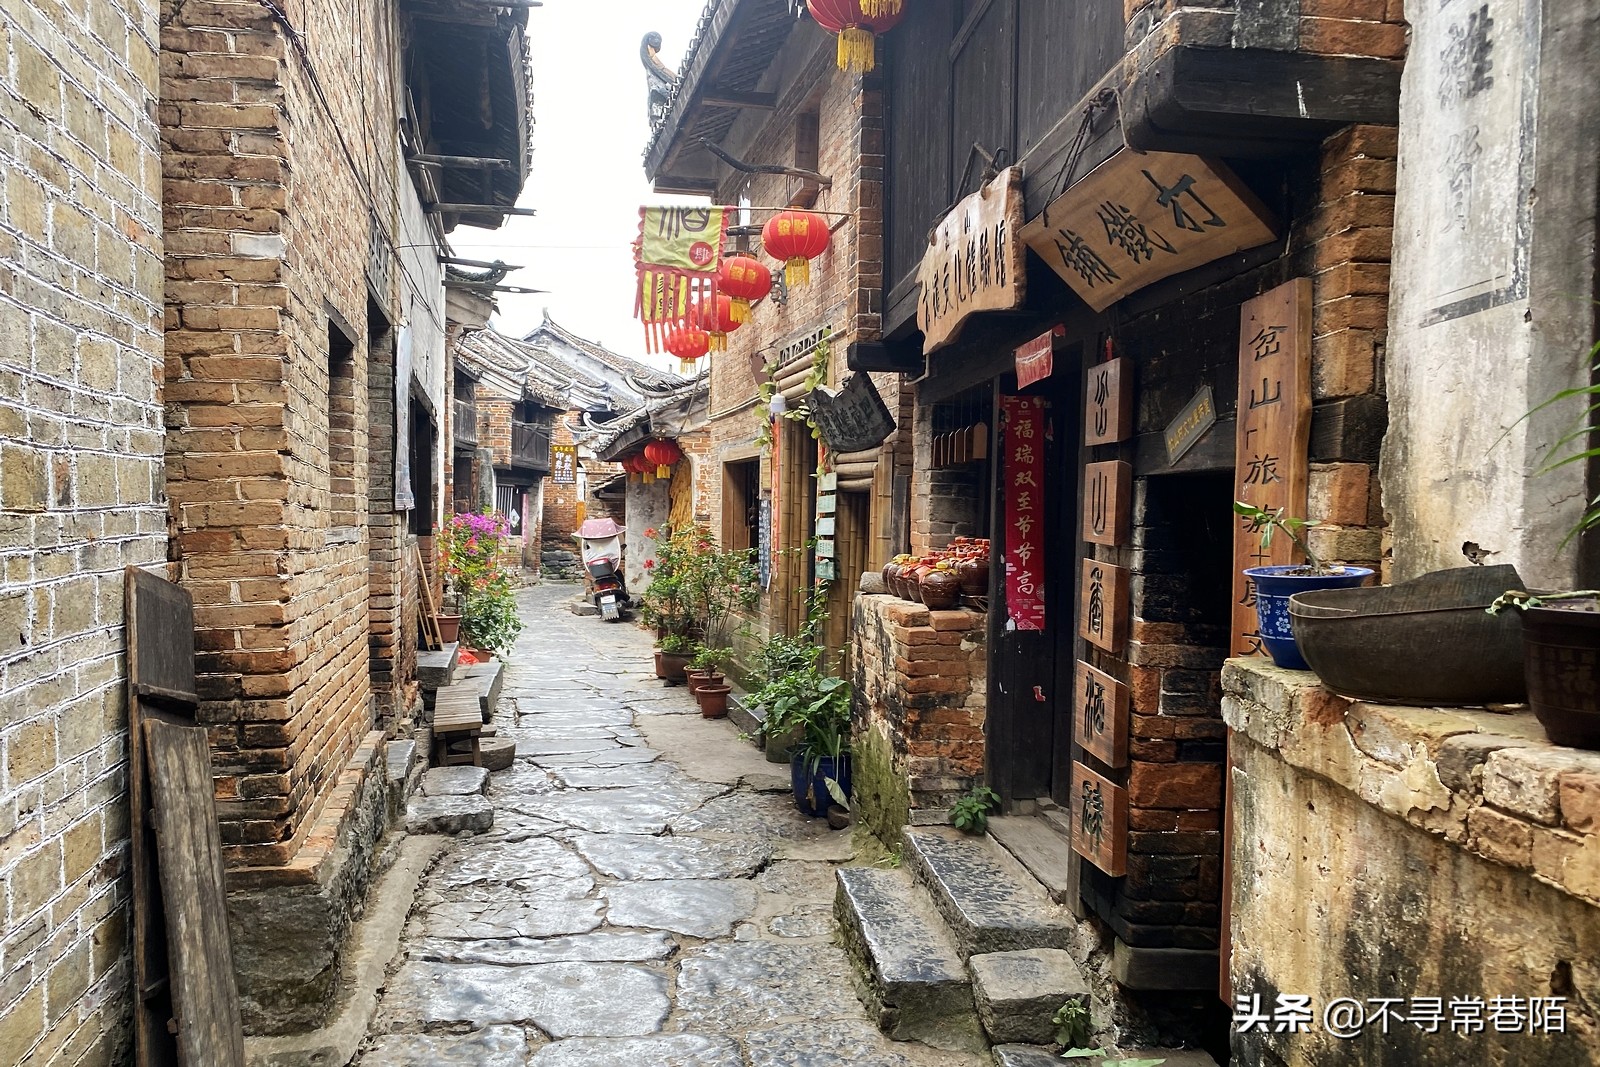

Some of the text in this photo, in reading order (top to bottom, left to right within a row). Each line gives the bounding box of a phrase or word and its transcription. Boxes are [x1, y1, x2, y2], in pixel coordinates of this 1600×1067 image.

[1013, 419, 1036, 595] 福瑞双至节节高
